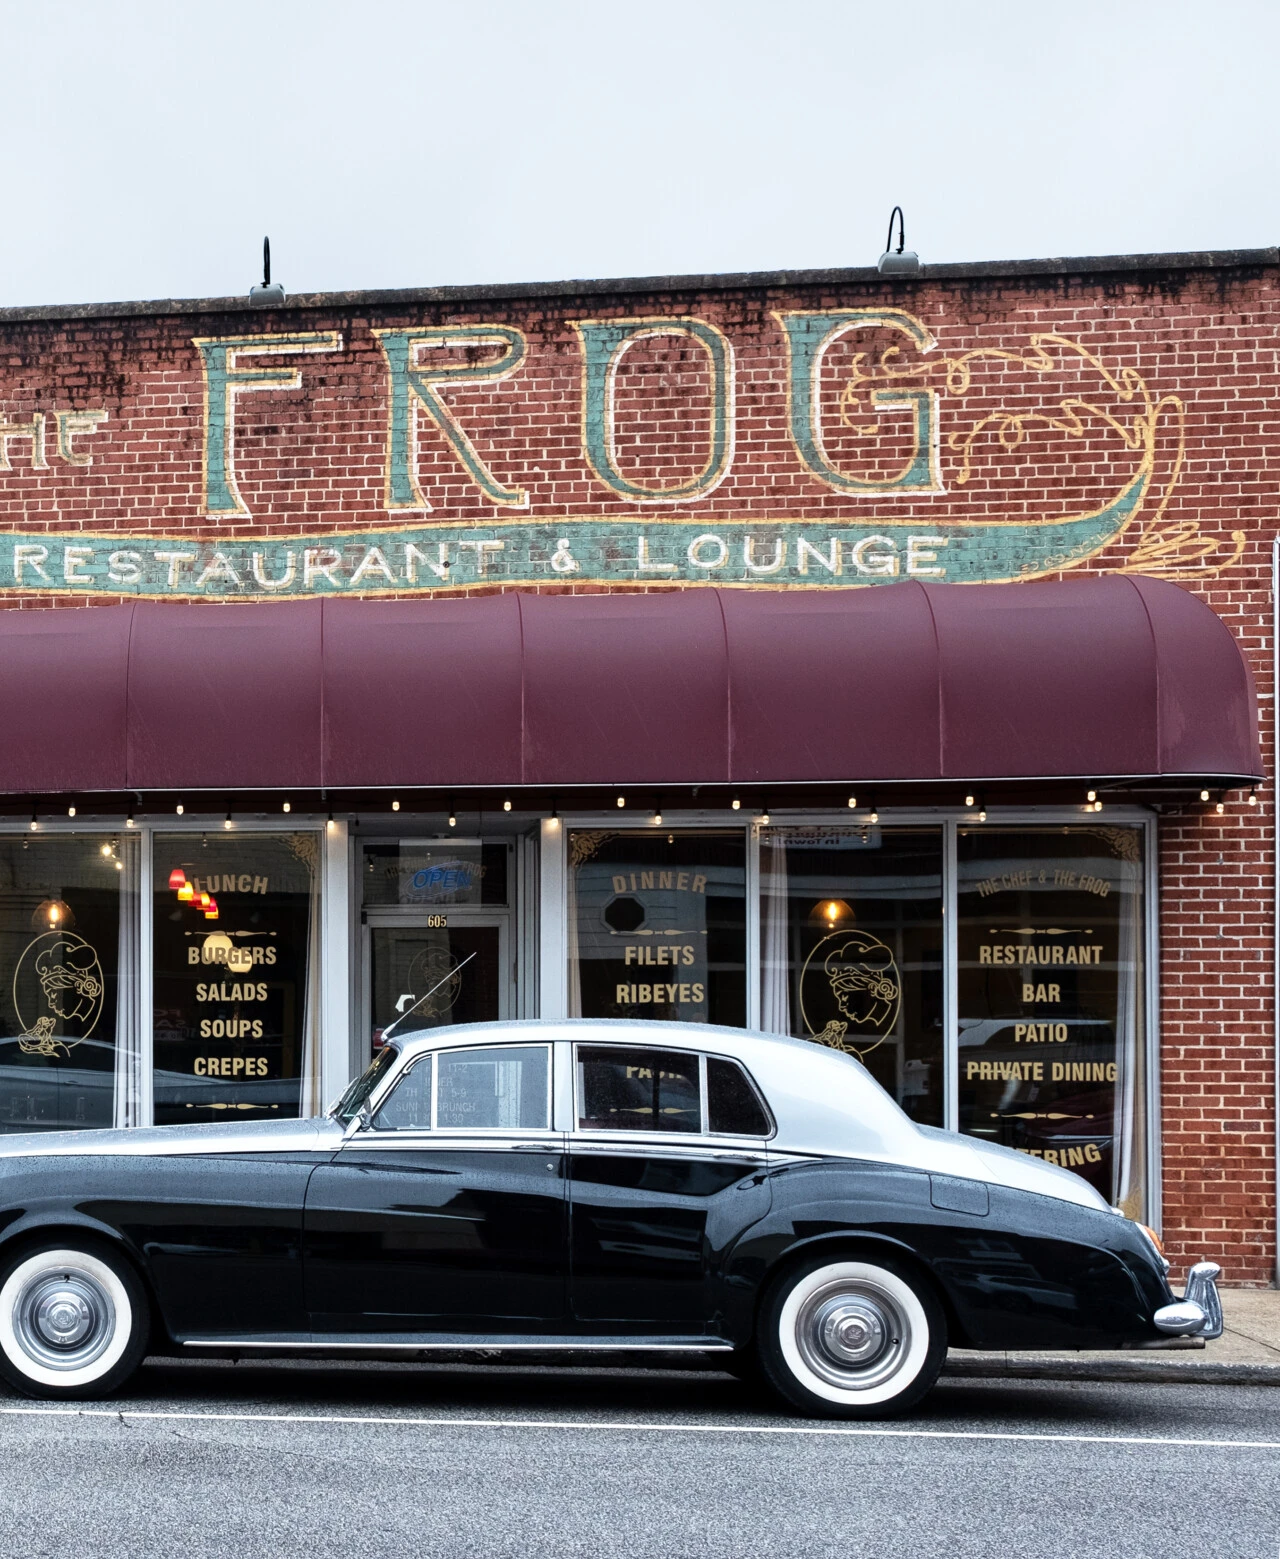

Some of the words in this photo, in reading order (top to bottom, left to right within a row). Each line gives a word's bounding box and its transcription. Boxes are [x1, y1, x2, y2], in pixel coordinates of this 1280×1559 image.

[189, 307, 948, 520] FROG
[13, 538, 507, 591] RESTAURANT
[550, 538, 582, 573] &
[637, 533, 949, 579] LOUNGE
[193, 874, 269, 895] LUNCH
[413, 869, 472, 889] OPEN
[612, 871, 708, 894] DINNER
[975, 878, 1001, 897] THE
[1002, 870, 1033, 889] CHEF
[1038, 869, 1046, 884] &
[1054, 869, 1076, 887] THE
[1078, 874, 1112, 897] FROG
[427, 914, 447, 928] 605
[188, 946, 277, 965] BURGERS
[625, 945, 695, 965] FILETS
[979, 945, 1103, 964] RESTAURANT
[196, 983, 268, 1002] SALADS
[616, 983, 705, 1003] RIBEYES
[1022, 984, 1060, 1003] BAR
[200, 1019, 263, 1038] SOUPS
[1015, 1023, 1068, 1043] PATIO
[194, 1057, 269, 1076] CREPES
[967, 1061, 1044, 1080] PRIVATE
[1052, 1062, 1118, 1082] DINING
